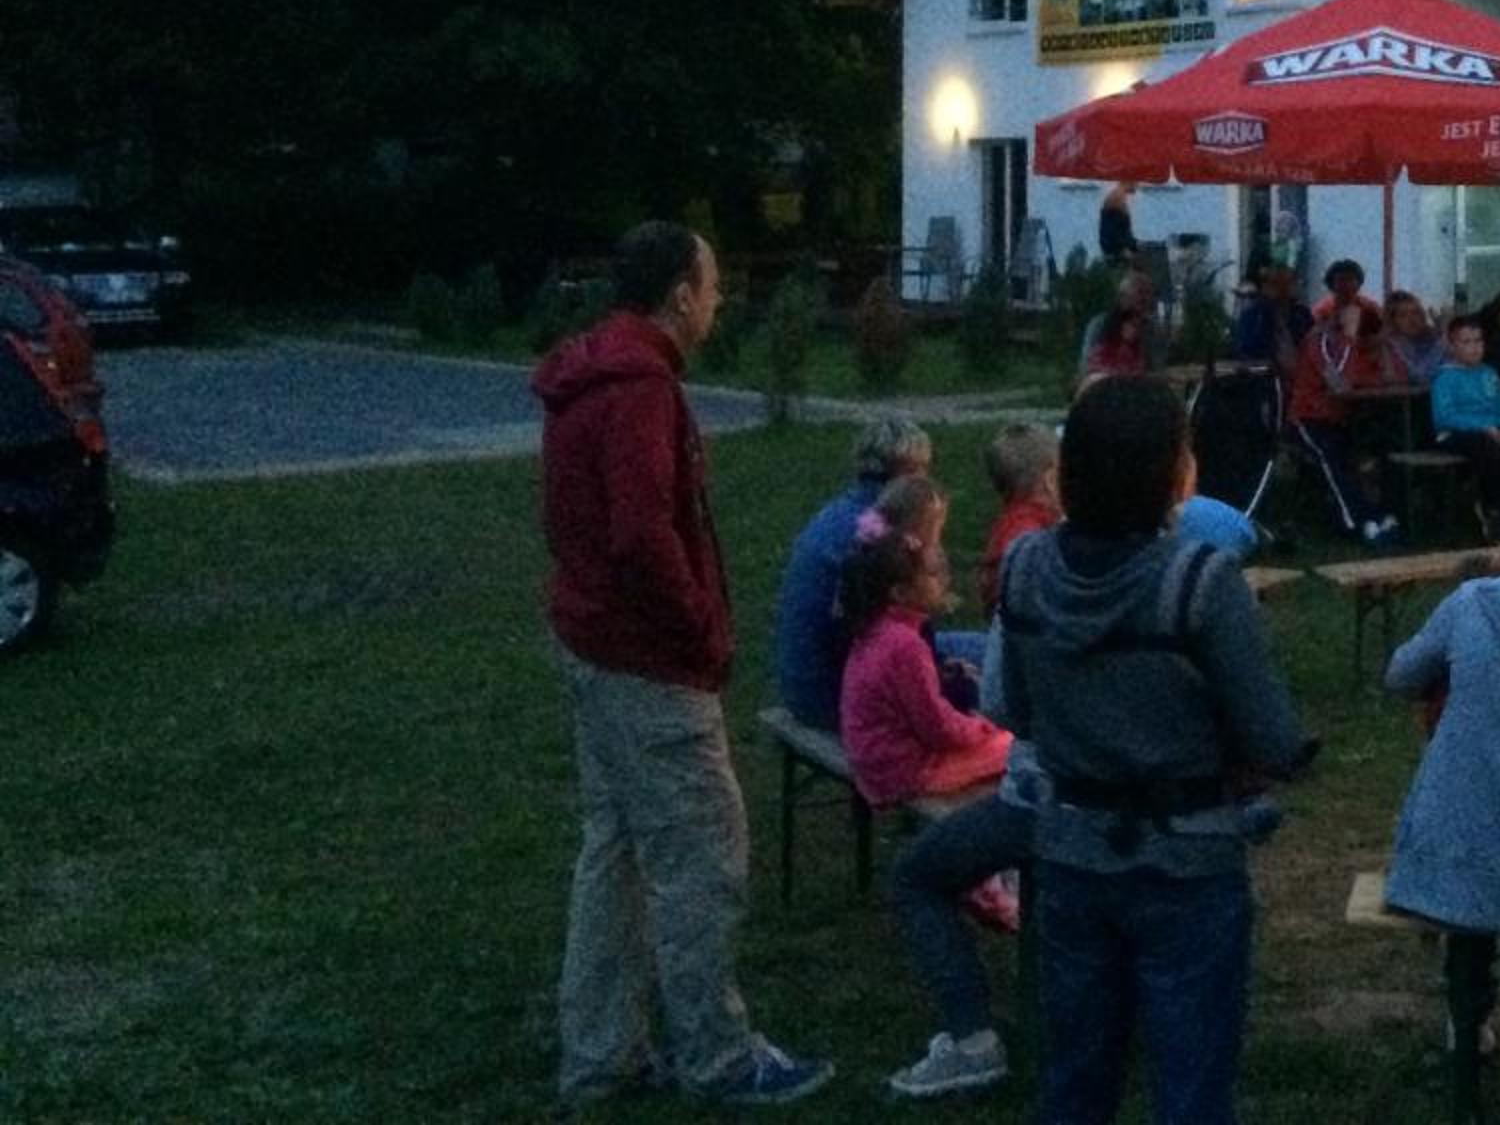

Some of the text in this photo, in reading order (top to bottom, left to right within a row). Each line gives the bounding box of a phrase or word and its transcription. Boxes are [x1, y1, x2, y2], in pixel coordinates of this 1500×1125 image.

[1263, 36, 1495, 79] WARKA
[1195, 122, 1264, 145] WARKA
[1441, 121, 1482, 140] JEST
